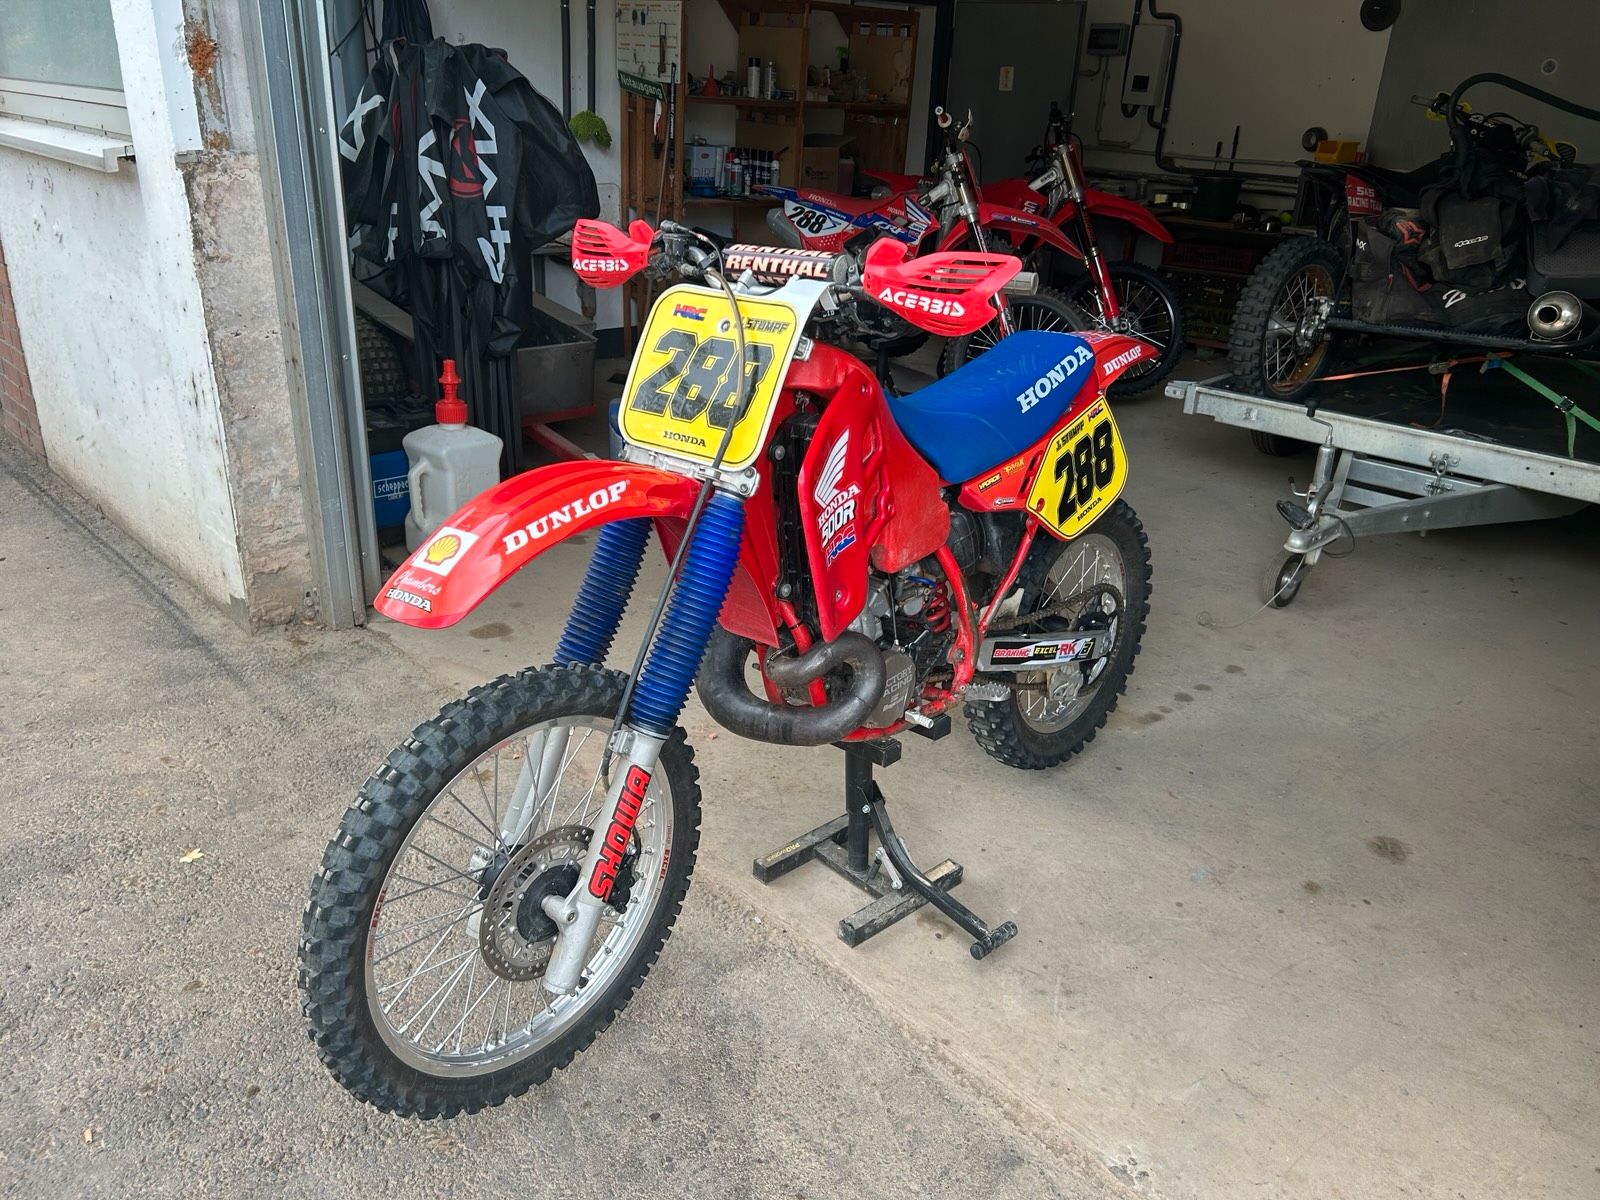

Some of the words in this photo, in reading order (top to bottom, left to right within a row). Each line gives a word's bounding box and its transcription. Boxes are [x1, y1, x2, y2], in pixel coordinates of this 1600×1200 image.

[620, 74, 663, 99] Notausgang
[808, 193, 837, 207] HONDA
[1348, 196, 1369, 208] RACING
[788, 206, 827, 234] 288
[573, 257, 629, 273] ACERBIS
[725, 255, 828, 278] RENTHAL
[673, 304, 708, 321] HRC
[878, 288, 965, 317] ACERBIS
[1103, 345, 1141, 376] DUNLOP
[630, 328, 775, 430] 288
[1016, 344, 1094, 414] HONDA
[1087, 403, 1104, 422] HRC
[663, 431, 707, 447] HONDA
[1055, 418, 1115, 528] 288
[378, 480, 408, 494] scheppac
[502, 480, 629, 555] DUNLOP
[818, 484, 861, 528] HONDA
[1077, 497, 1103, 521] HONDA
[821, 499, 856, 548] 500R
[826, 523, 856, 567] HRC
[385, 588, 432, 612] HONDA
[993, 648, 1031, 658] BRAKING
[1034, 646, 1057, 654] EXCEL
[1059, 642, 1078, 655] RK
[883, 674, 913, 698] ACING
[886, 664, 913, 687] CTORY
[588, 764, 652, 903] SHOWA
[658, 848, 670, 881] EXCEL
